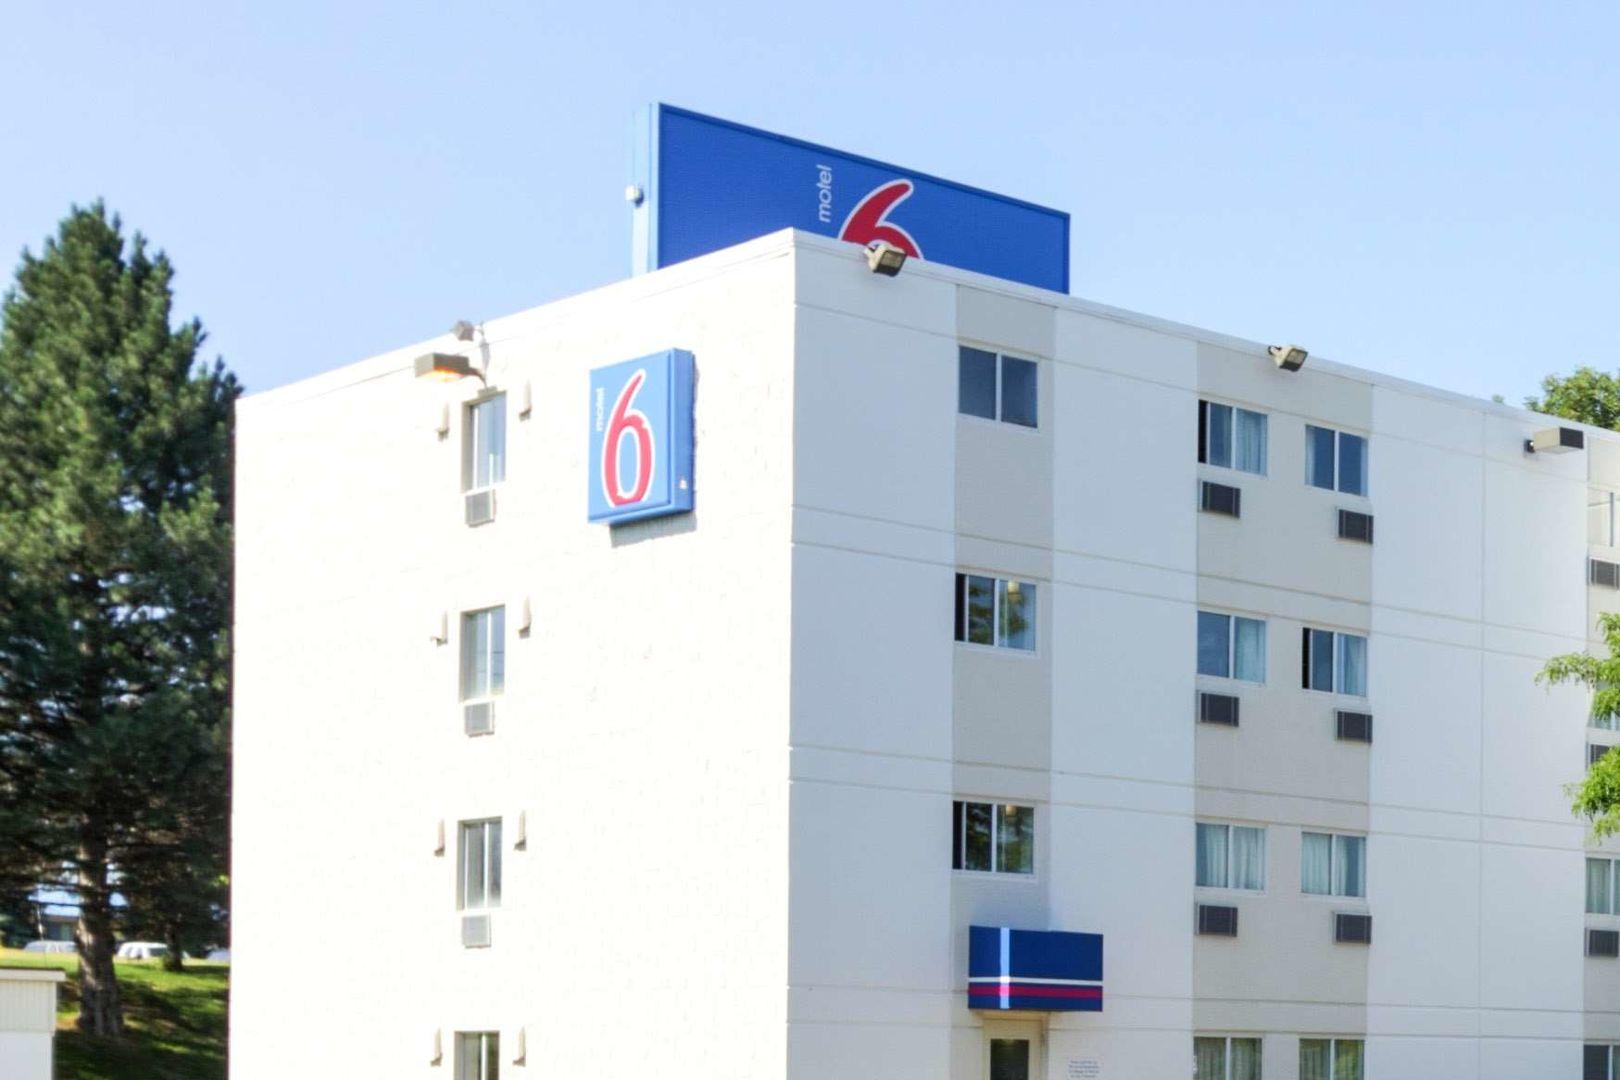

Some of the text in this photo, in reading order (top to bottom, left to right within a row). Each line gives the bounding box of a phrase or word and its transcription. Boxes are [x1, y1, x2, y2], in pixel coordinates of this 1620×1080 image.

[816, 164, 832, 223] motel
[595, 387, 605, 432] motel
[602, 368, 655, 507] 6
